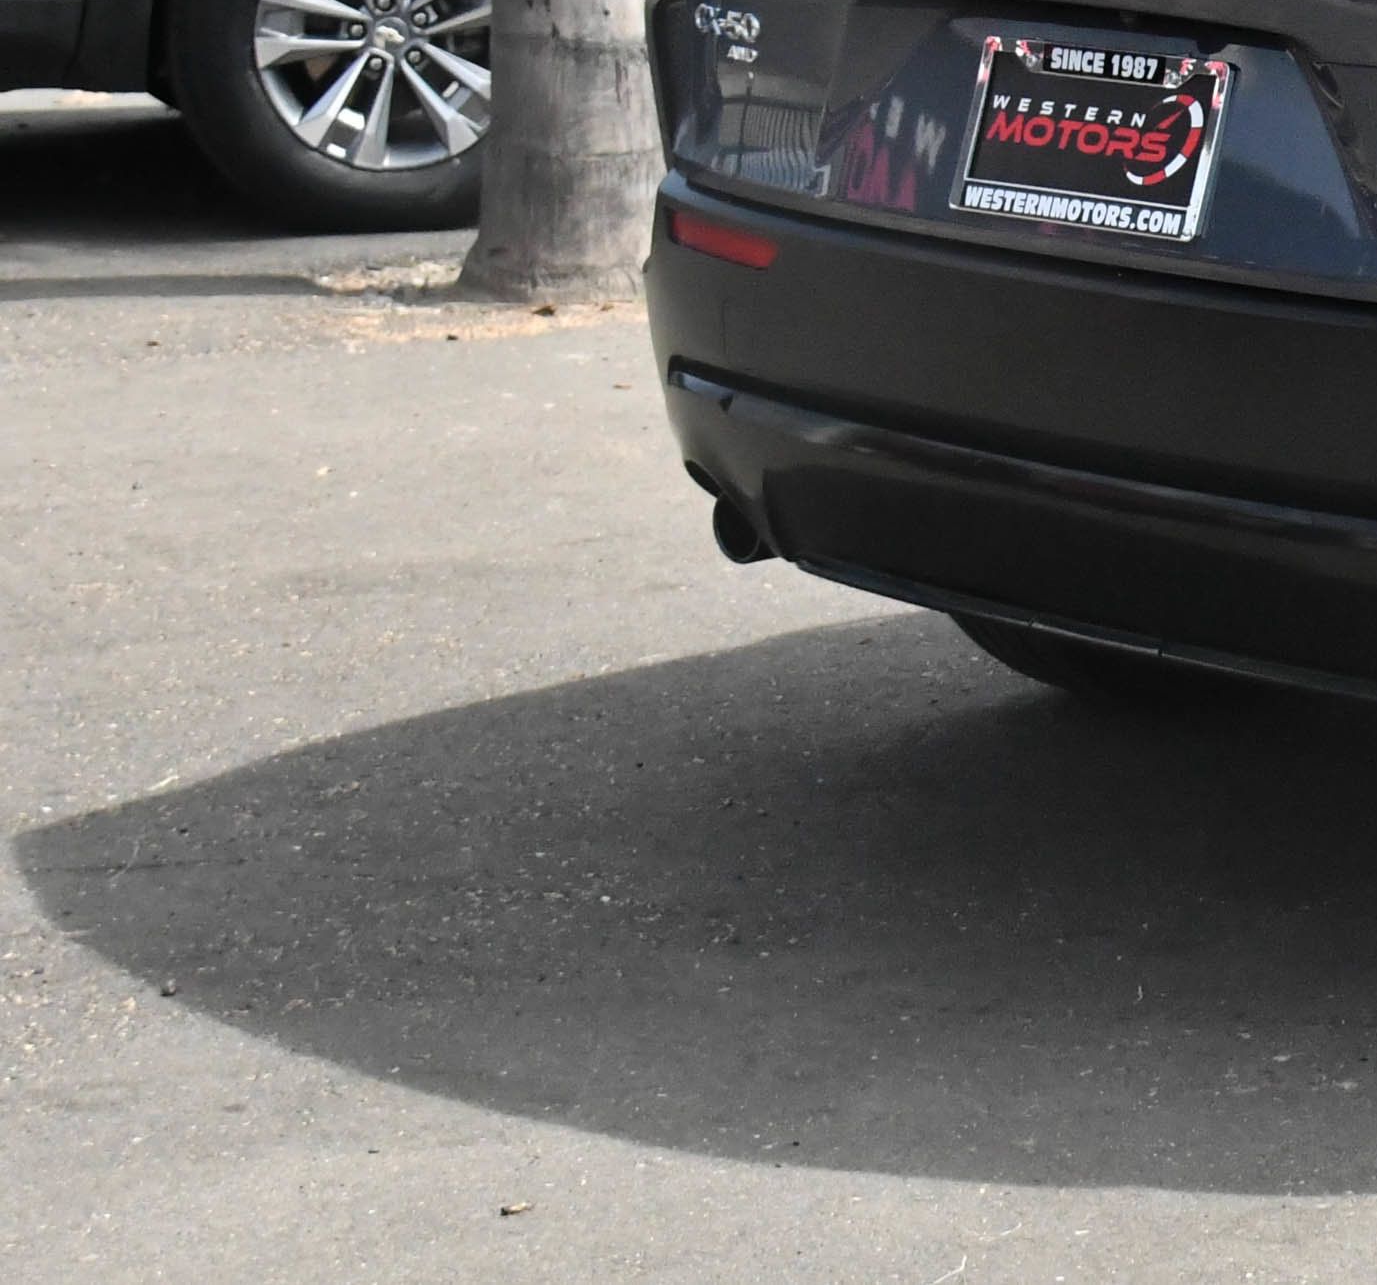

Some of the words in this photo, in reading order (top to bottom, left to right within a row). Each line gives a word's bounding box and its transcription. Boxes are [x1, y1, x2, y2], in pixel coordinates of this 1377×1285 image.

[1050, 46, 1105, 75] SINCE
[1111, 54, 1159, 81] 1987
[992, 93, 1147, 129] WESTERN
[985, 110, 1172, 163] MOTORS
[963, 185, 1183, 236] WESTERNMOTORS.COM
